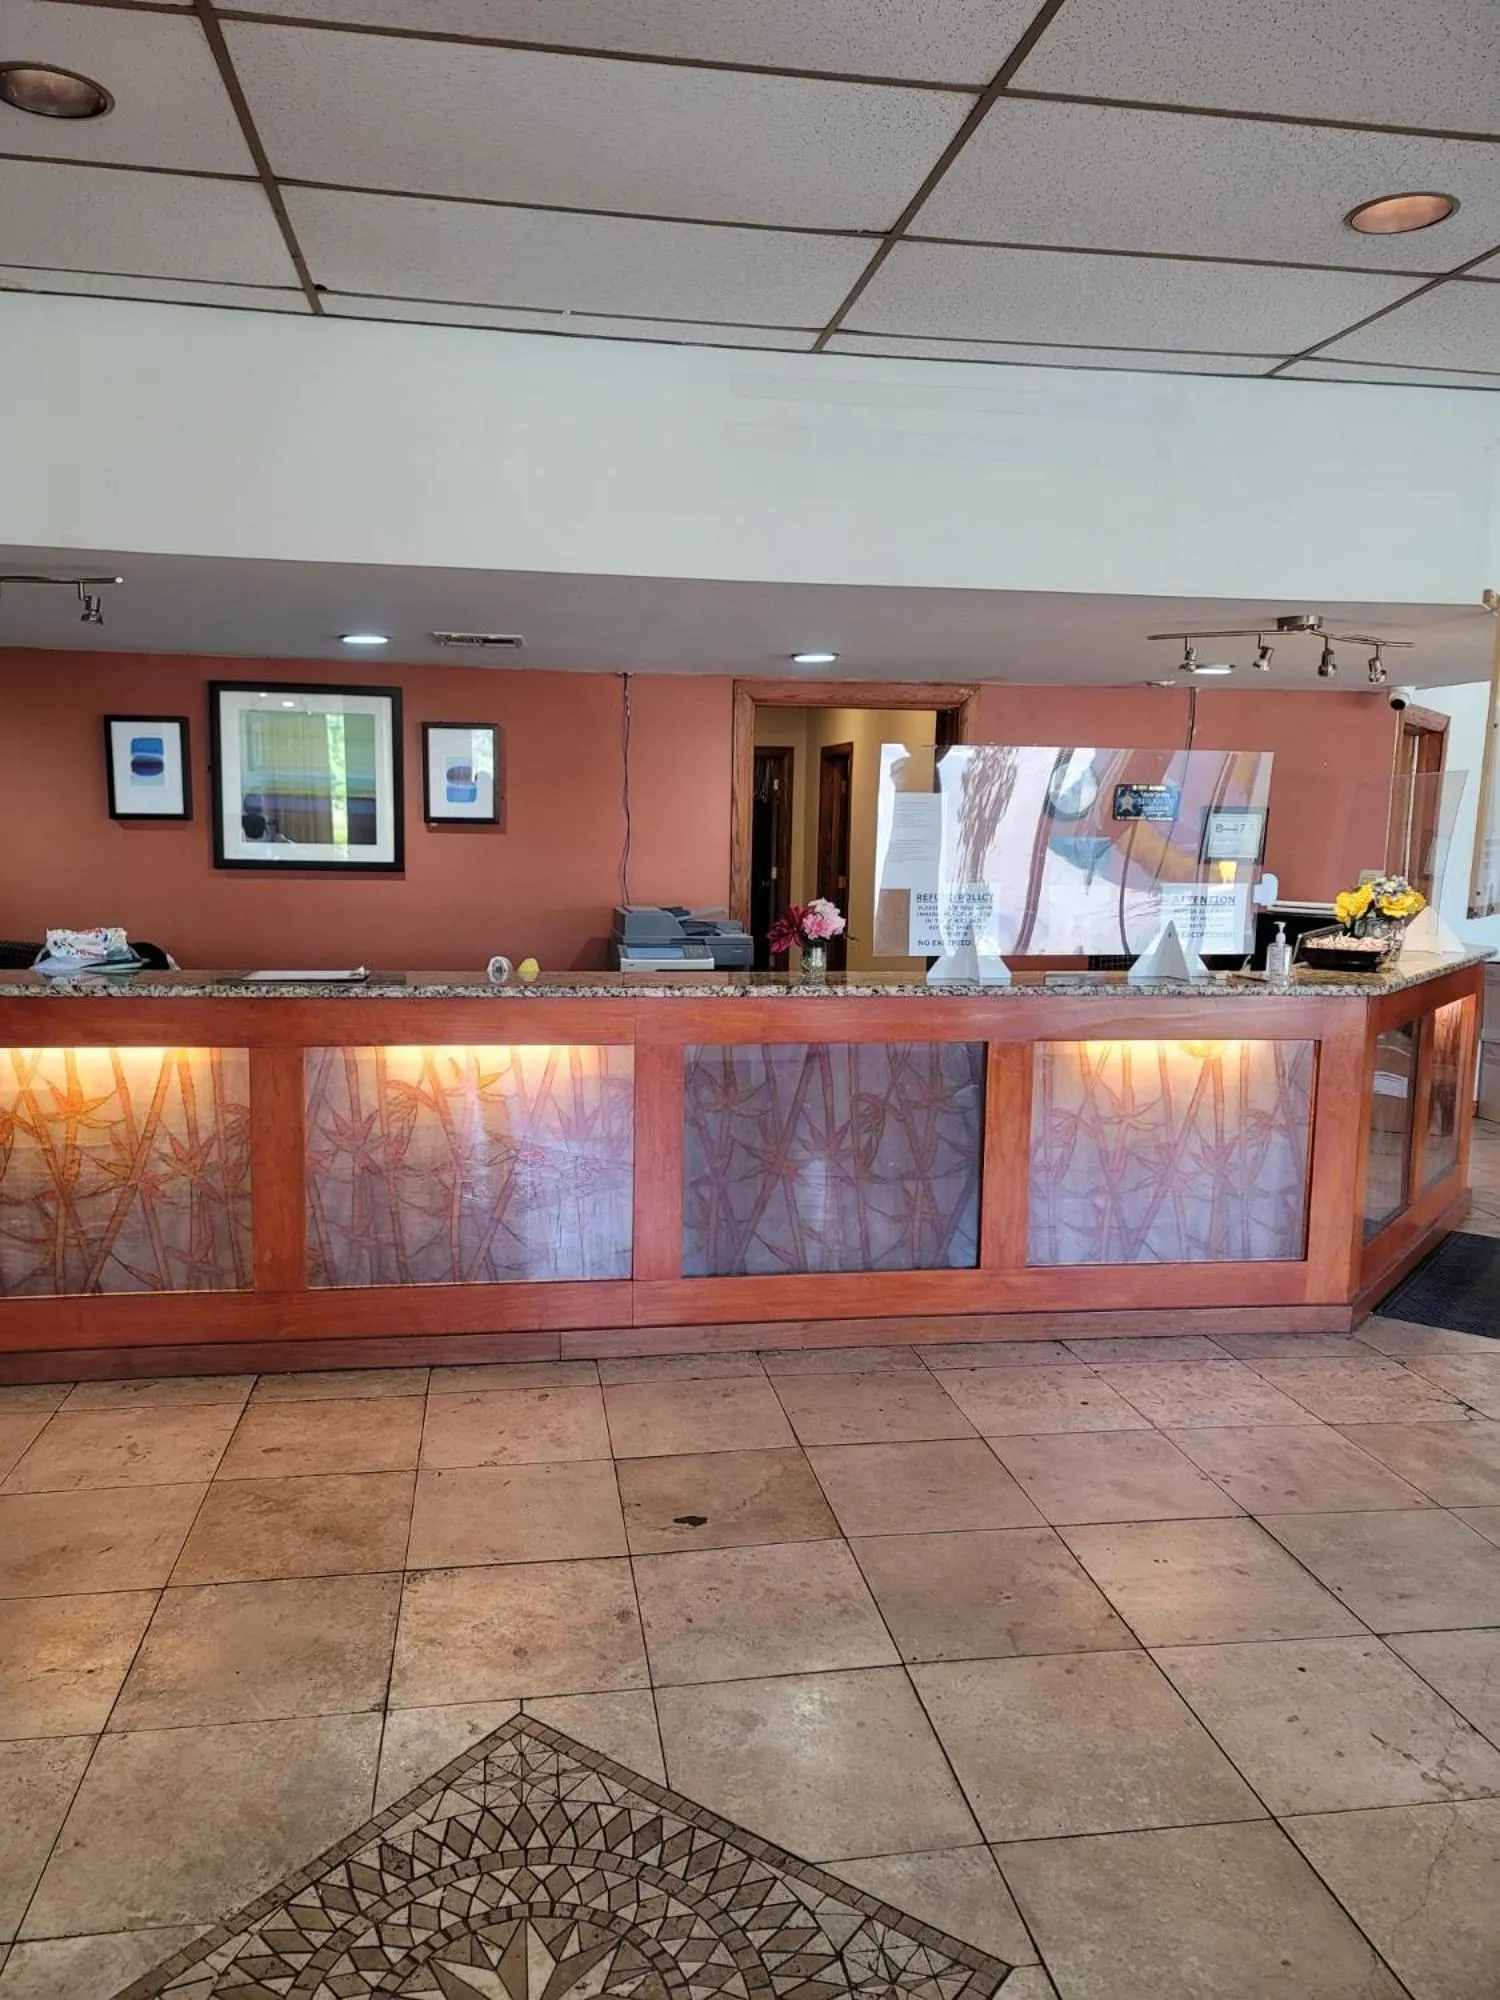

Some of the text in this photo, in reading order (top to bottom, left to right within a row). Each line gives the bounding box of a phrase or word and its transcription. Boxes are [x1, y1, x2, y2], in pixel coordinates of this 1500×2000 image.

[916, 892, 993, 903] REFUD POLICY
[1171, 895, 1237, 905] ATTENTION
